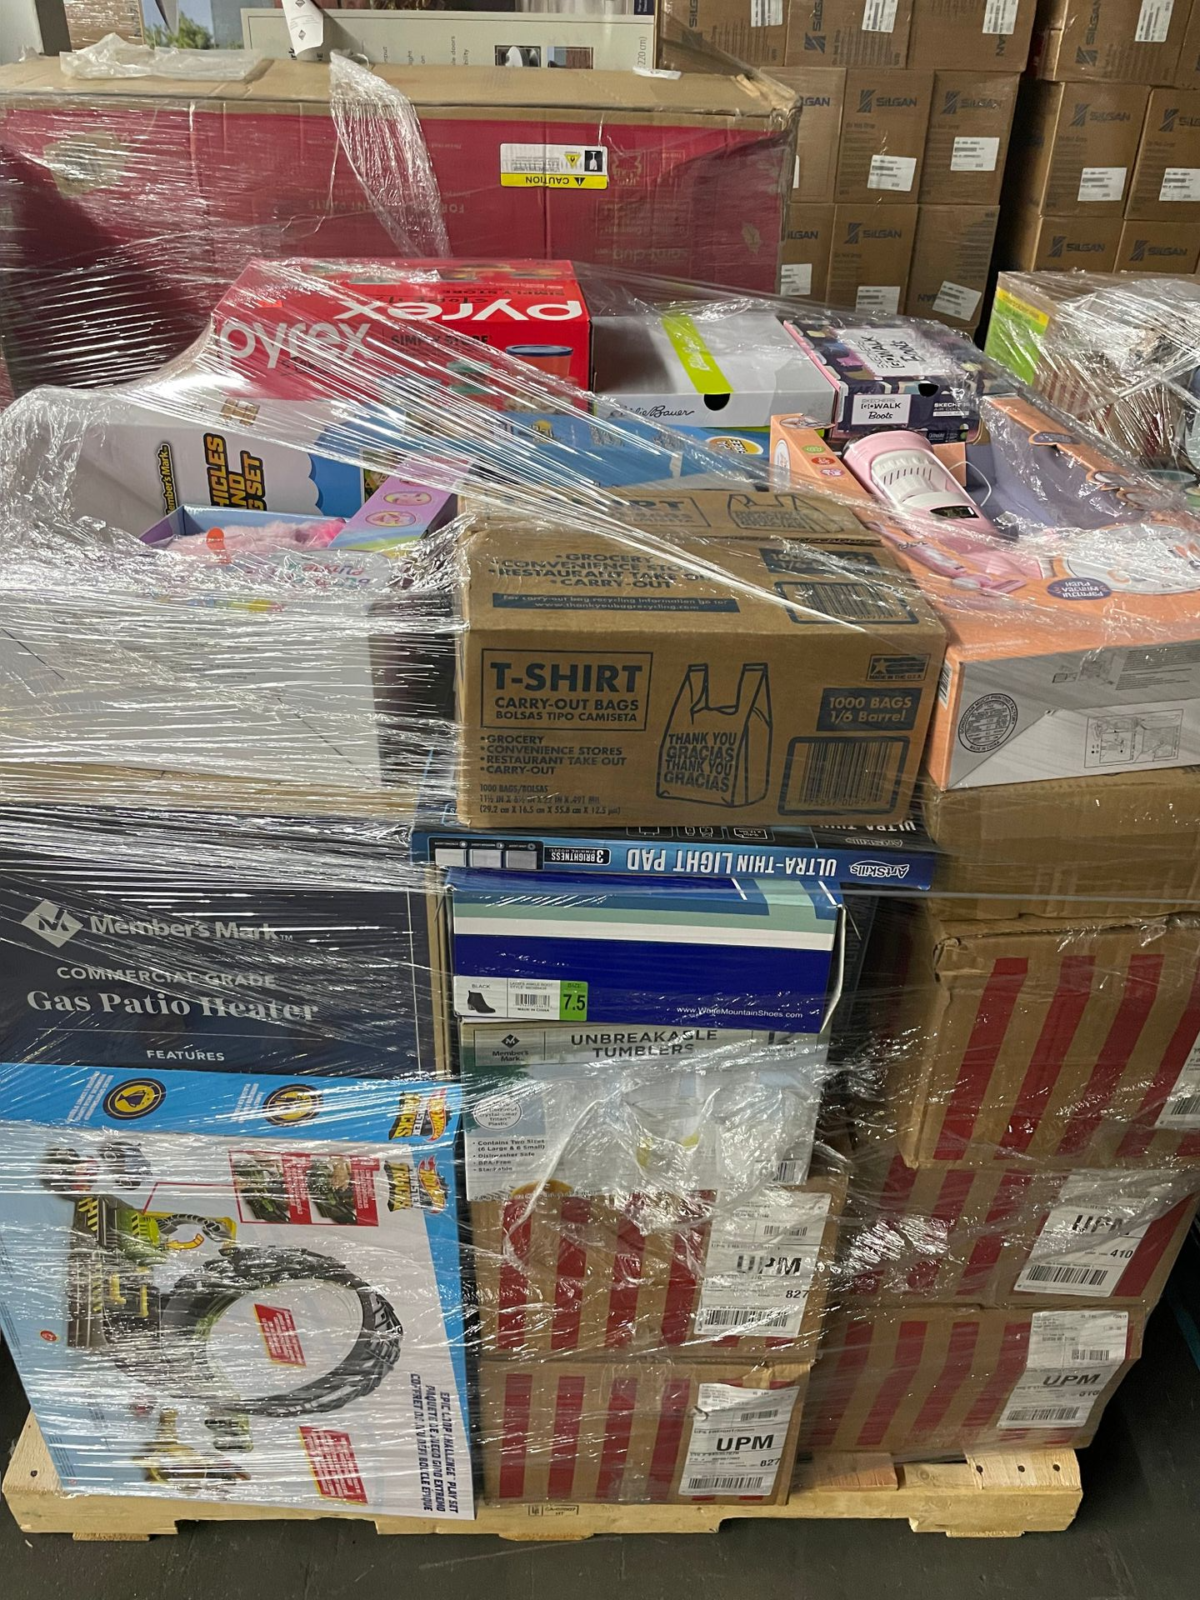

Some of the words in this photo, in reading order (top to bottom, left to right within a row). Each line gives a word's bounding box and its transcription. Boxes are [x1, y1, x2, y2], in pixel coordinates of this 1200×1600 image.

[875, 96, 918, 108] SILGAN
[525, 176, 570, 185] CAUTION
[787, 230, 819, 240] ILGAN
[862, 229, 902, 239] SILGAN
[334, 298, 583, 321] pyrex
[219, 321, 371, 370] pyrex
[868, 411, 893, 420] Boots
[243, 454, 263, 496] SET
[228, 474, 247, 509] ND
[562, 552, 652, 563] GROCERY
[501, 558, 641, 572] CONVENIENCE
[499, 568, 629, 580] RESTAURANT
[559, 578, 673, 589] CARRY-OUT
[490, 661, 643, 693] T-SHIRT
[494, 696, 590, 711] CARRY-OUT
[594, 698, 639, 711] BAGS
[828, 696, 866, 710] 1000
[869, 696, 913, 710] BAGS
[496, 710, 543, 720] BOLSAS
[546, 712, 574, 721] TIPO
[578, 712, 638, 722] CAMISETA
[829, 710, 854, 725] 1/6
[857, 710, 906, 723] Barrel
[487, 734, 545, 745] GROCERY
[667, 732, 709, 746] THANK
[711, 732, 738, 747] YOU
[486, 745, 575, 755] CONVENIENCE
[578, 746, 623, 756] STORES
[665, 745, 736, 764] GRACIAS
[486, 754, 564, 765] RESTAURANT
[568, 756, 598, 765] TAKE
[601, 757, 628, 766] OUT
[486, 765, 557, 775] CARRY-OUT
[664, 758, 706, 773] THANK
[707, 760, 734, 777] YOU
[479, 783, 498, 793] 1000
[663, 770, 731, 794] GRACIAS
[479, 805, 498, 815] (29.2
[550, 852, 596, 863] BRIGHTNESS
[595, 849, 605, 863] 3
[626, 847, 666, 872] PAD
[672, 850, 734, 874] LIGHT
[736, 855, 838, 877] ULTRA-THIN
[850, 859, 910, 879] ArtSkills
[89, 915, 211, 938] Member's
[56, 966, 197, 985] COMMERCIAL
[205, 973, 276, 987] GRADE
[26, 990, 92, 1012] Gas
[97, 991, 191, 1016] Patio
[200, 996, 320, 1021] Heater
[562, 993, 587, 1012] 7.5
[570, 1029, 718, 1047] UNBREAKABLE
[146, 1049, 226, 1062] FEATURES
[591, 1043, 695, 1058] TUMBLERS
[489, 1145, 508, 1153] Large
[1109, 1249, 1134, 1260] 410
[785, 1289, 809, 1299] 827
[1042, 1373, 1103, 1387] UPM
[440, 1391, 452, 1412] EPIC
[716, 1434, 775, 1452] UPM
[759, 1457, 781, 1467] 827
[434, 1478, 446, 1513] EXTREMO
[446, 1481, 458, 1500] PLAY
[448, 1500, 459, 1514] SET
